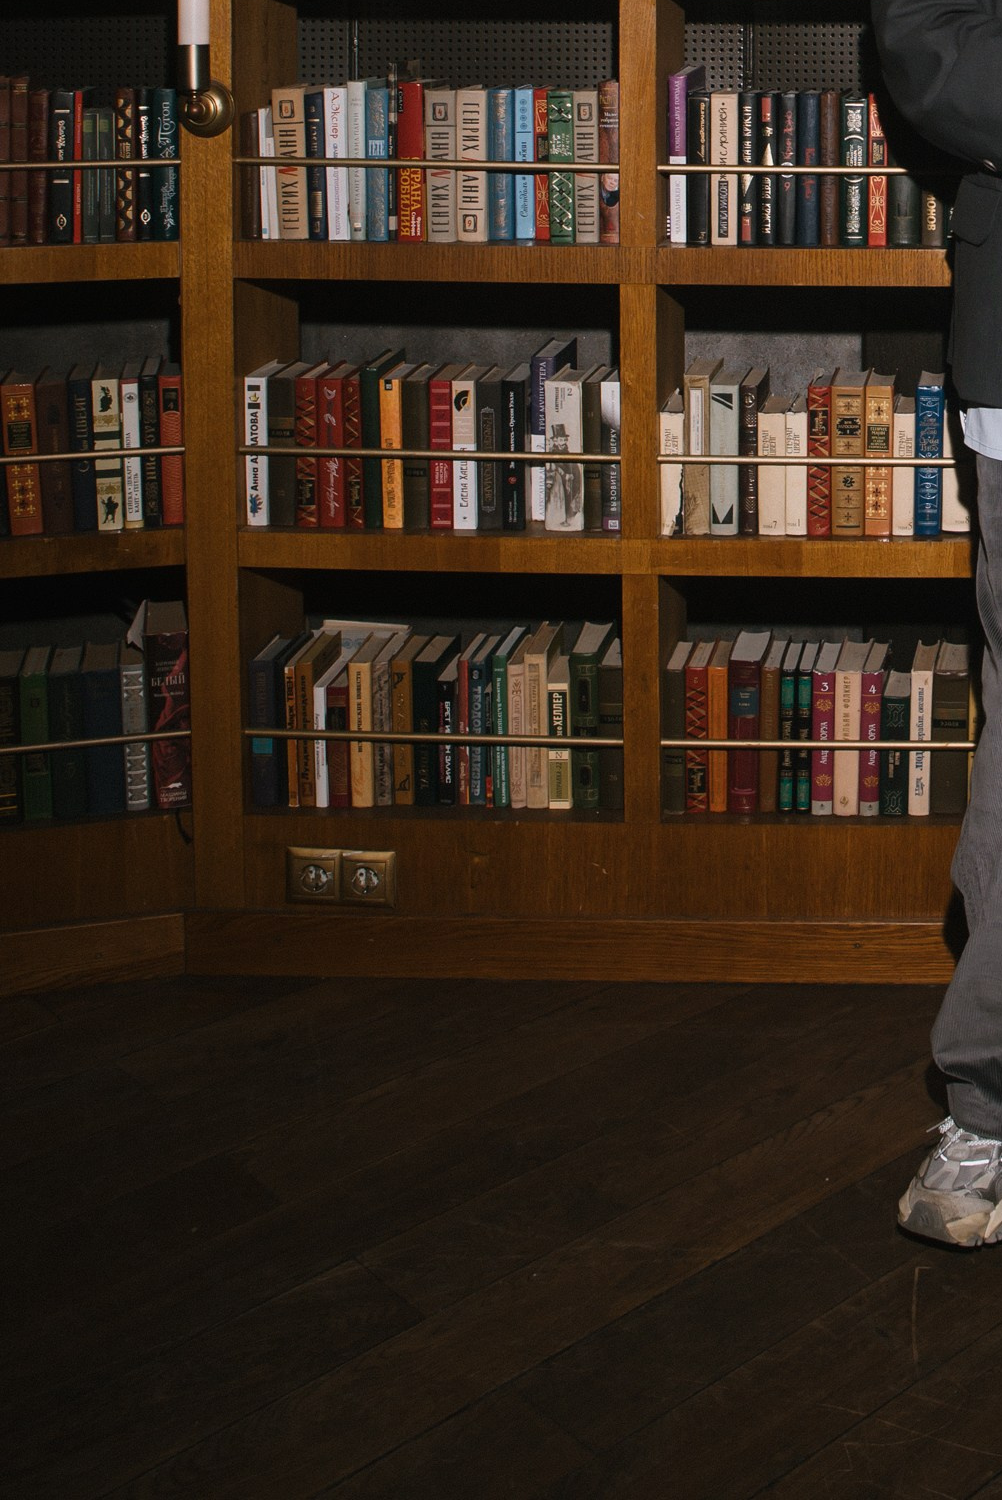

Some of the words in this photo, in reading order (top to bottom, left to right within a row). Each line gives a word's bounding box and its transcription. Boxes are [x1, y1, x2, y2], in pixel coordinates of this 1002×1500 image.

[673, 80, 682, 105] ГОРОДАХ
[462, 102, 480, 151] ГЕНРИХ
[742, 106, 752, 137] КРИСТИ
[674, 126, 682, 152] ПОВЕСТЬ
[743, 140, 753, 164] АГАТА
[762, 176, 773, 200] АГАТА
[281, 181, 301, 231] ГЕНРИХ
[431, 184, 450, 234] ГЕНРИХ
[576, 184, 596, 234] ГЕНРИХ
[762, 203, 773, 234] КРИСТИ
[538, 361, 549, 412] МУШКЕТЕРА
[538, 414, 547, 431] ТРИ
[250, 467, 259, 492] Анна
[609, 470, 618, 512] ВЫЗОВИТЕ
[126, 491, 134, 514] СЕНЕКА
[286, 675, 295, 703] ТВЕН
[820, 681, 829, 693] 3
[842, 675, 851, 709] ФОЛКНЕР
[868, 684, 877, 695] 4
[445, 701, 453, 724] БРЕТ
[553, 692, 564, 726] ХЕЛЛЕР
[445, 754, 453, 784] ЭЛЛИС
